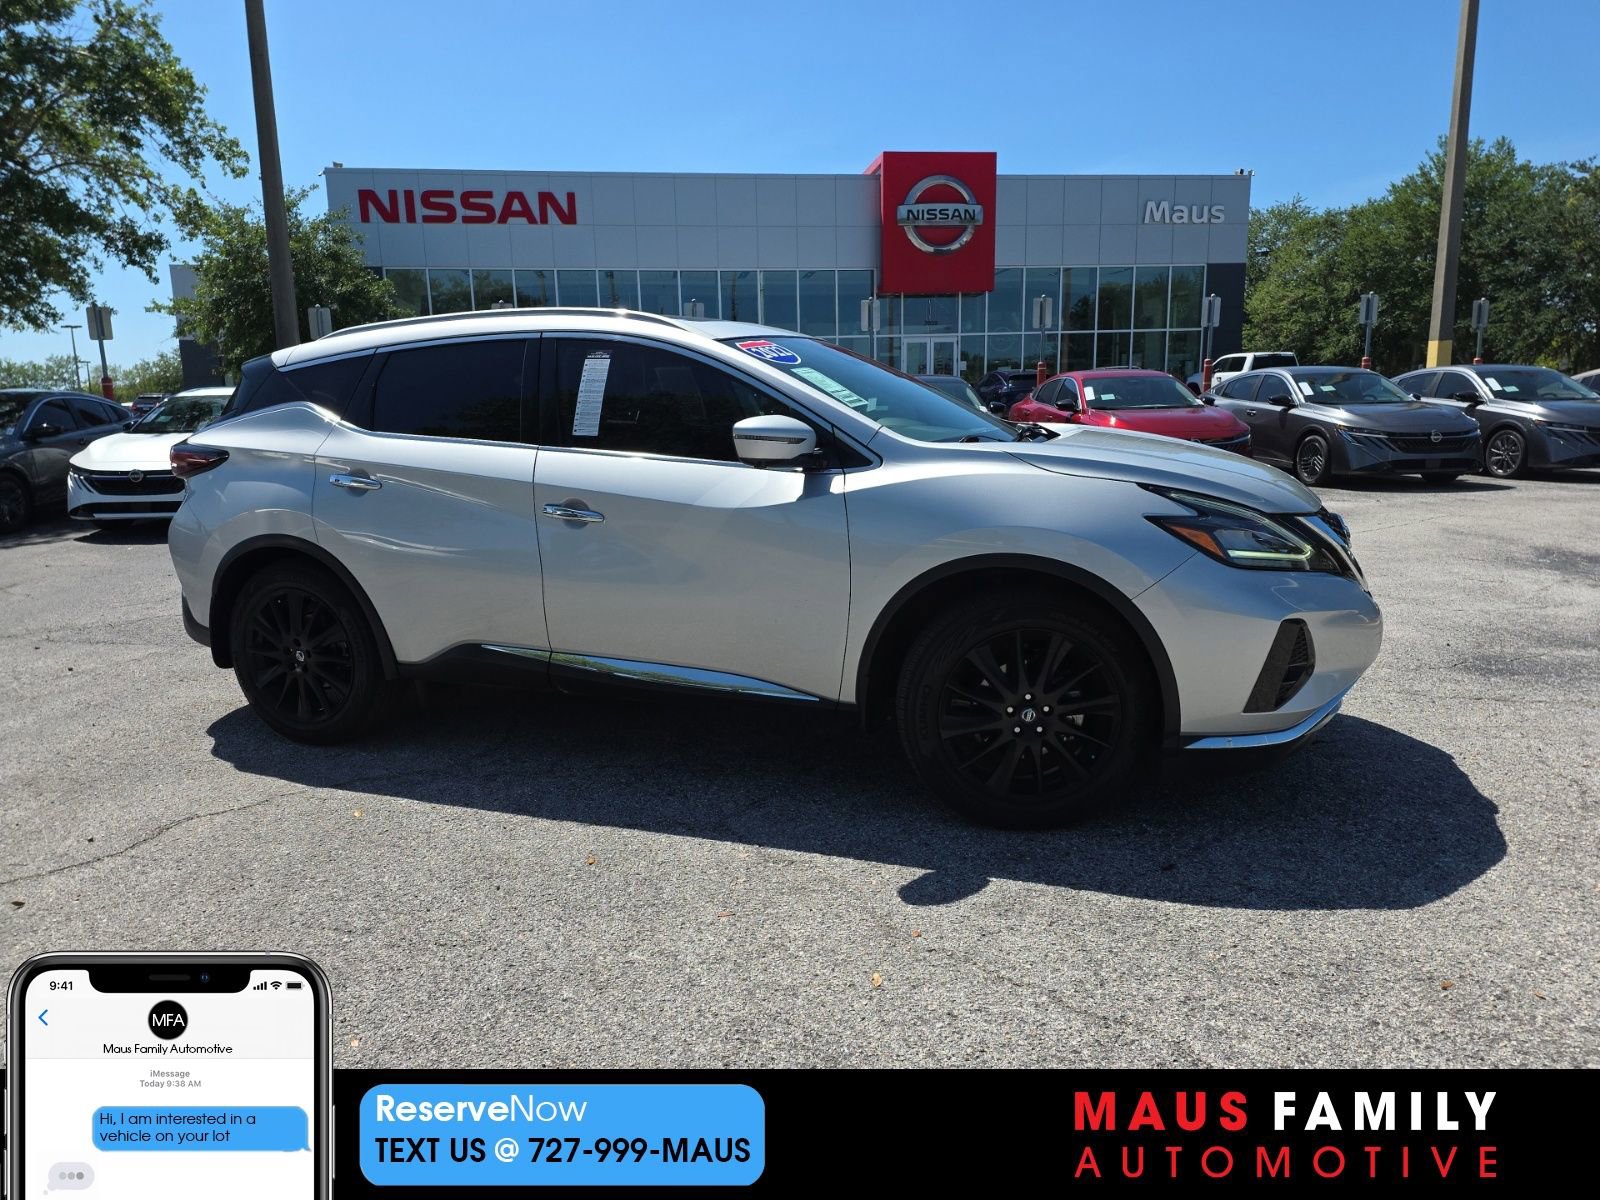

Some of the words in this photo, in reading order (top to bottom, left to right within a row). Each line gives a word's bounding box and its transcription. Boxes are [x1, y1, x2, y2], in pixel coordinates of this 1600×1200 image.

[357, 189, 577, 224] NISSAN
[906, 208, 976, 221] NISSAN
[1144, 200, 1225, 224] Maus
